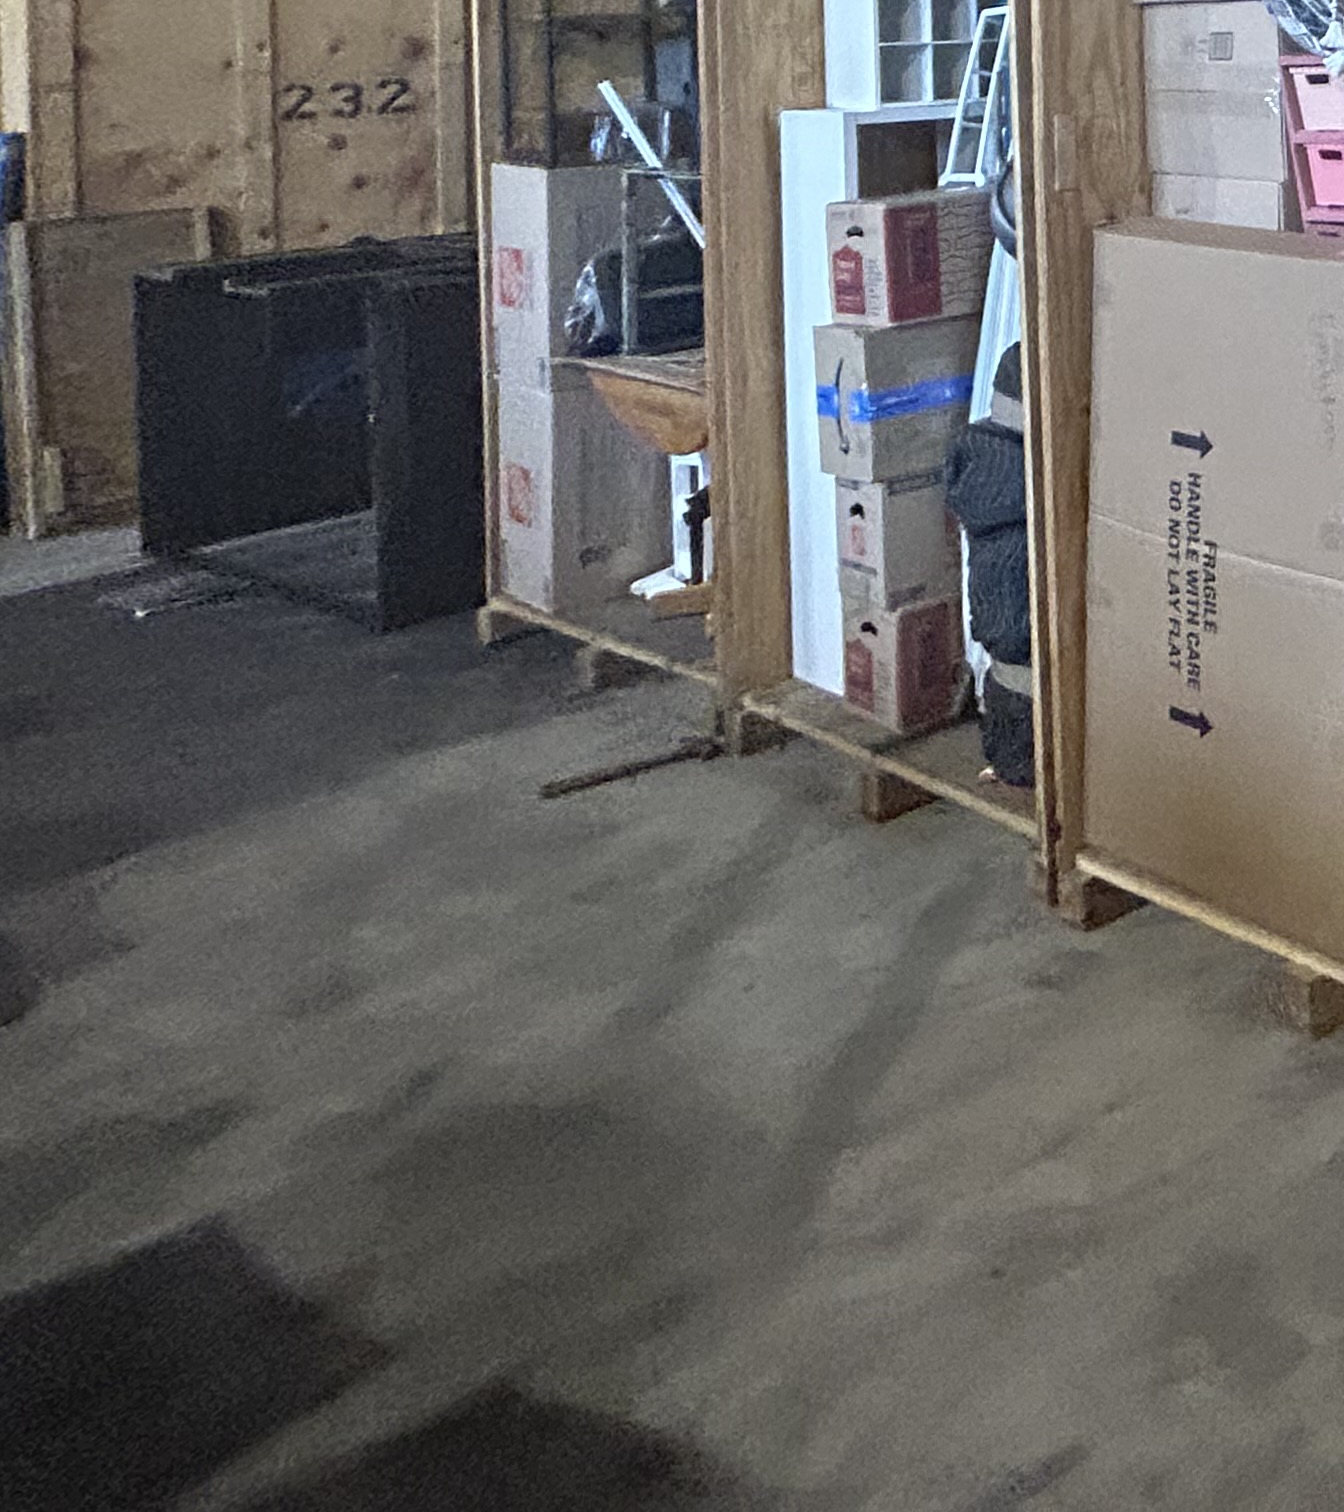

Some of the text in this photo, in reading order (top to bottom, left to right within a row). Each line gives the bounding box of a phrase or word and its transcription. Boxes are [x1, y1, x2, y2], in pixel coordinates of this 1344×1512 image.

[281, 75, 417, 122] 232
[1167, 479, 1182, 674] DO NOT LAY FLAT
[1185, 471, 1202, 692] HANDLE WITH CARE
[1201, 539, 1218, 635] FRAGILE
